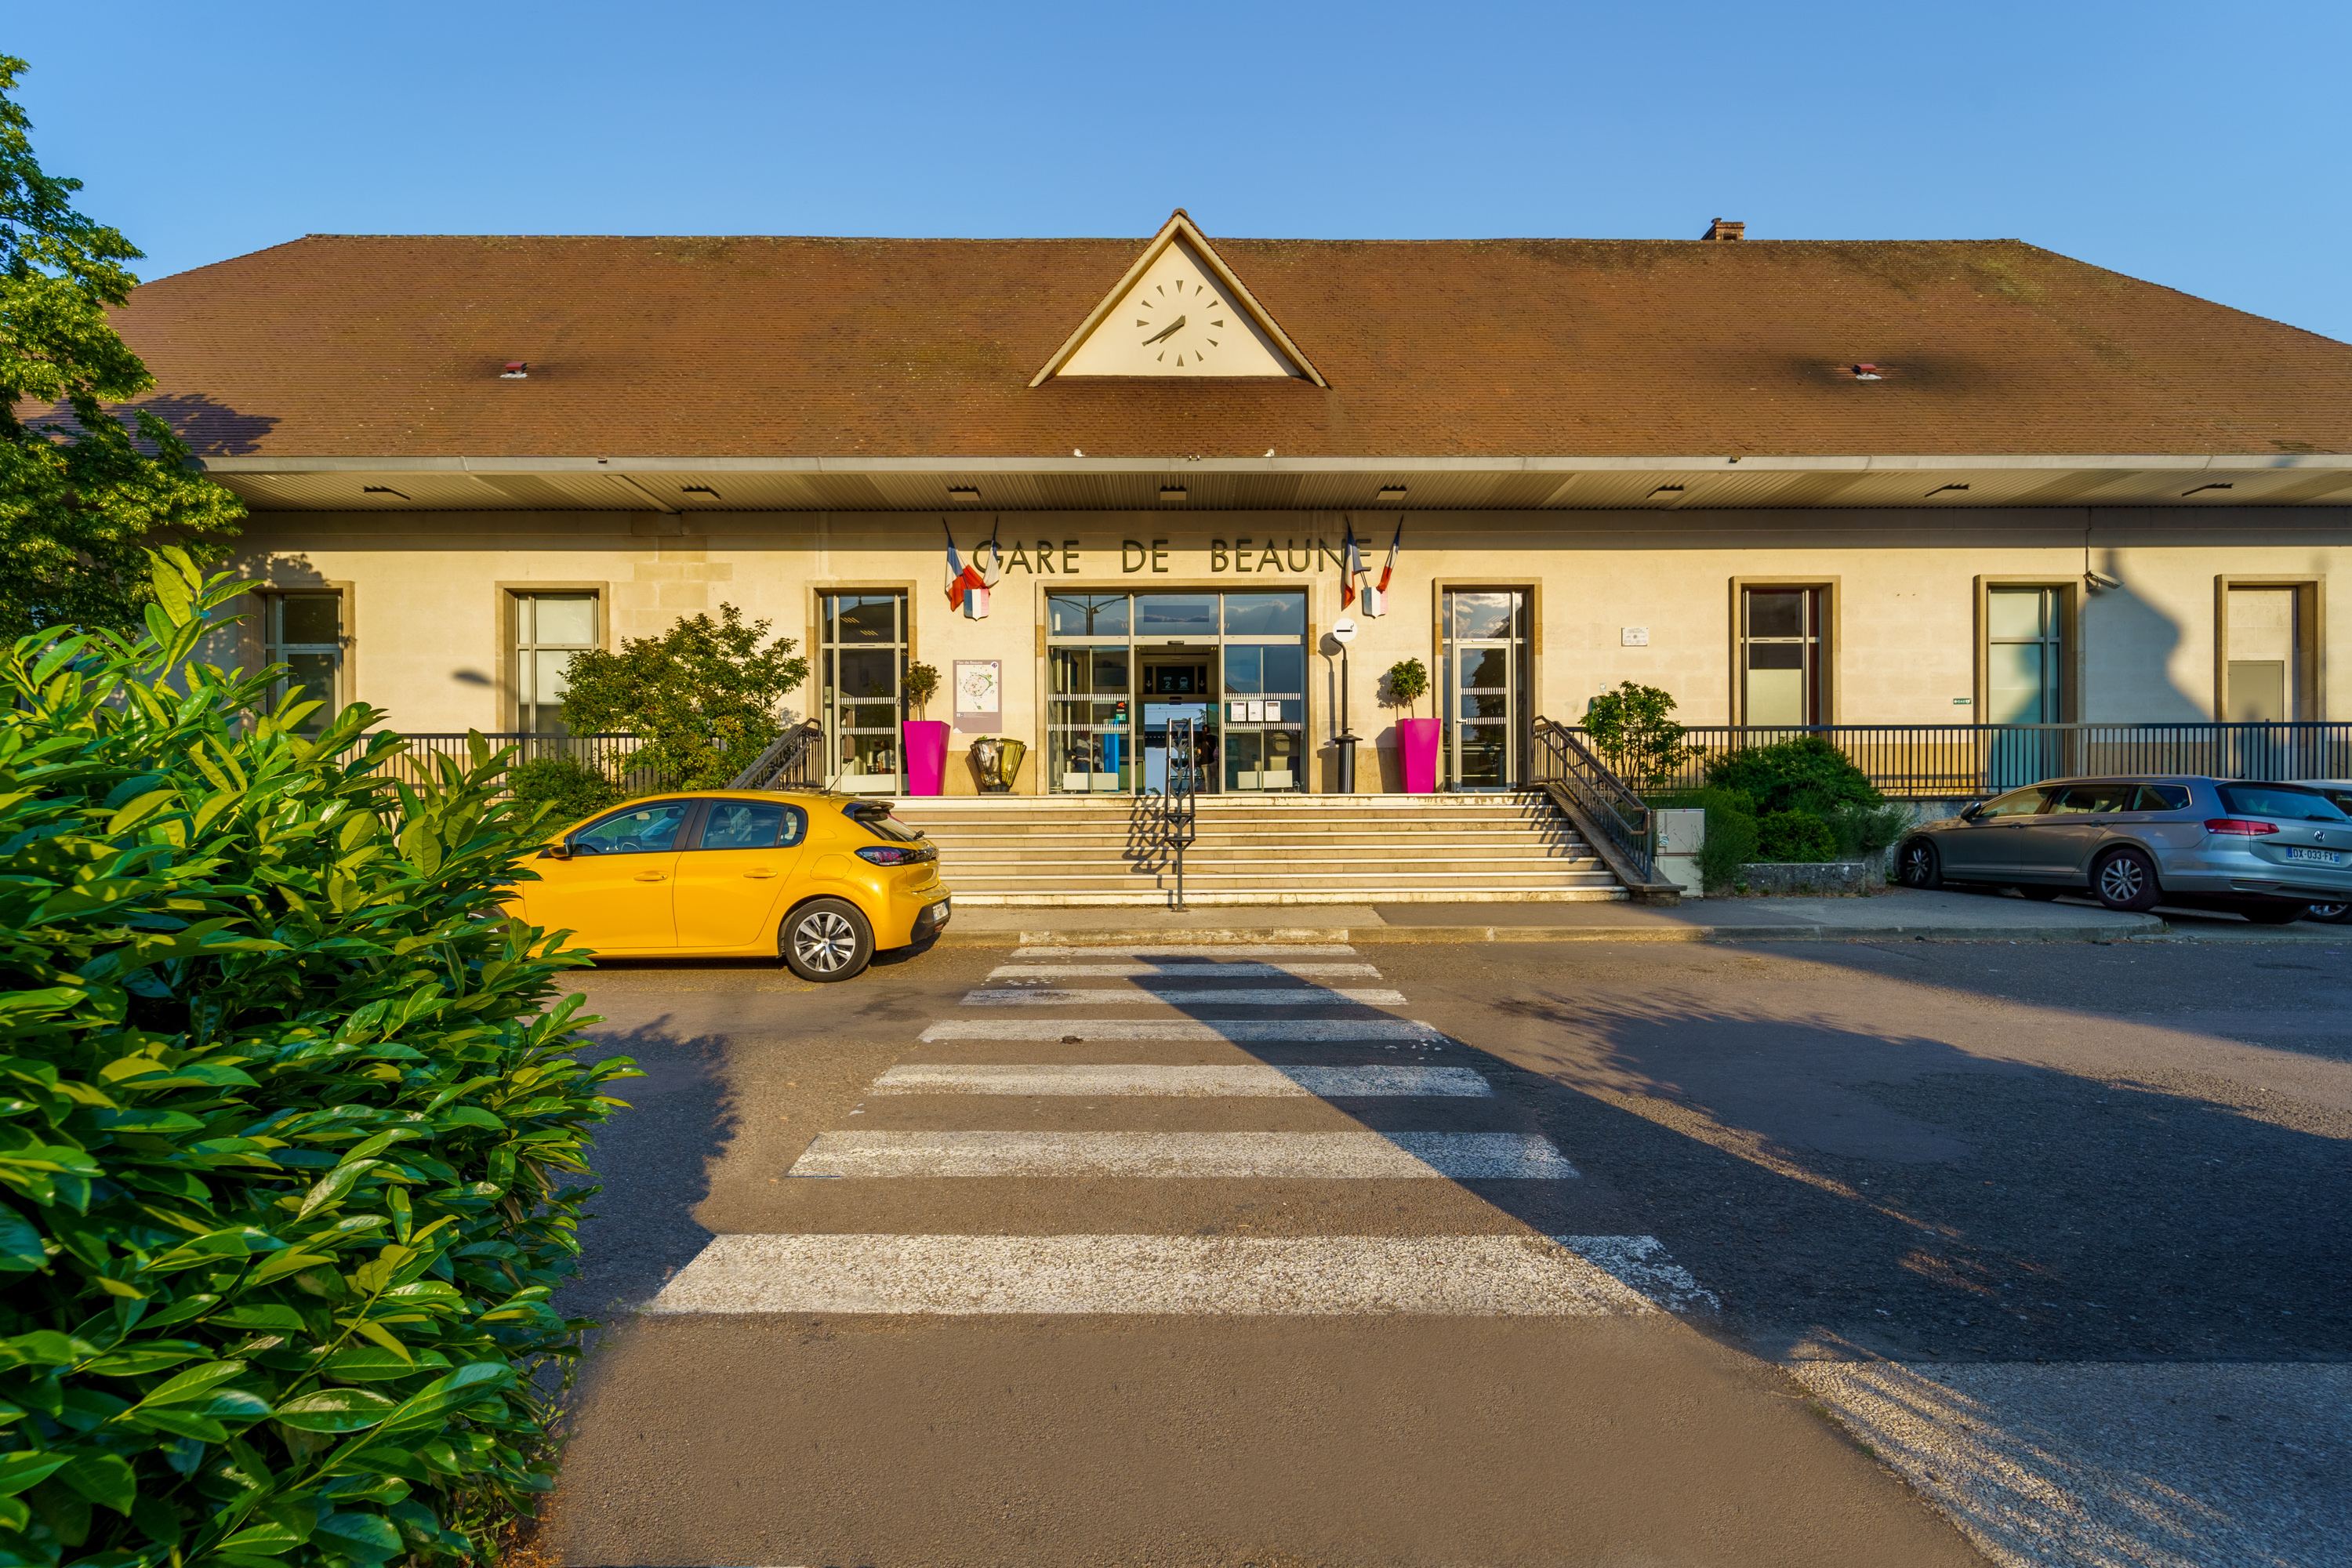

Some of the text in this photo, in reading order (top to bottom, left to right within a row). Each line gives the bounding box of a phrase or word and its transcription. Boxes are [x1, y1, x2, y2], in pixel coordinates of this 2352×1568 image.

[972, 539, 1372, 574] GARE DE BEAUNE
[2292, 848, 2333, 861] DX-033-FX
